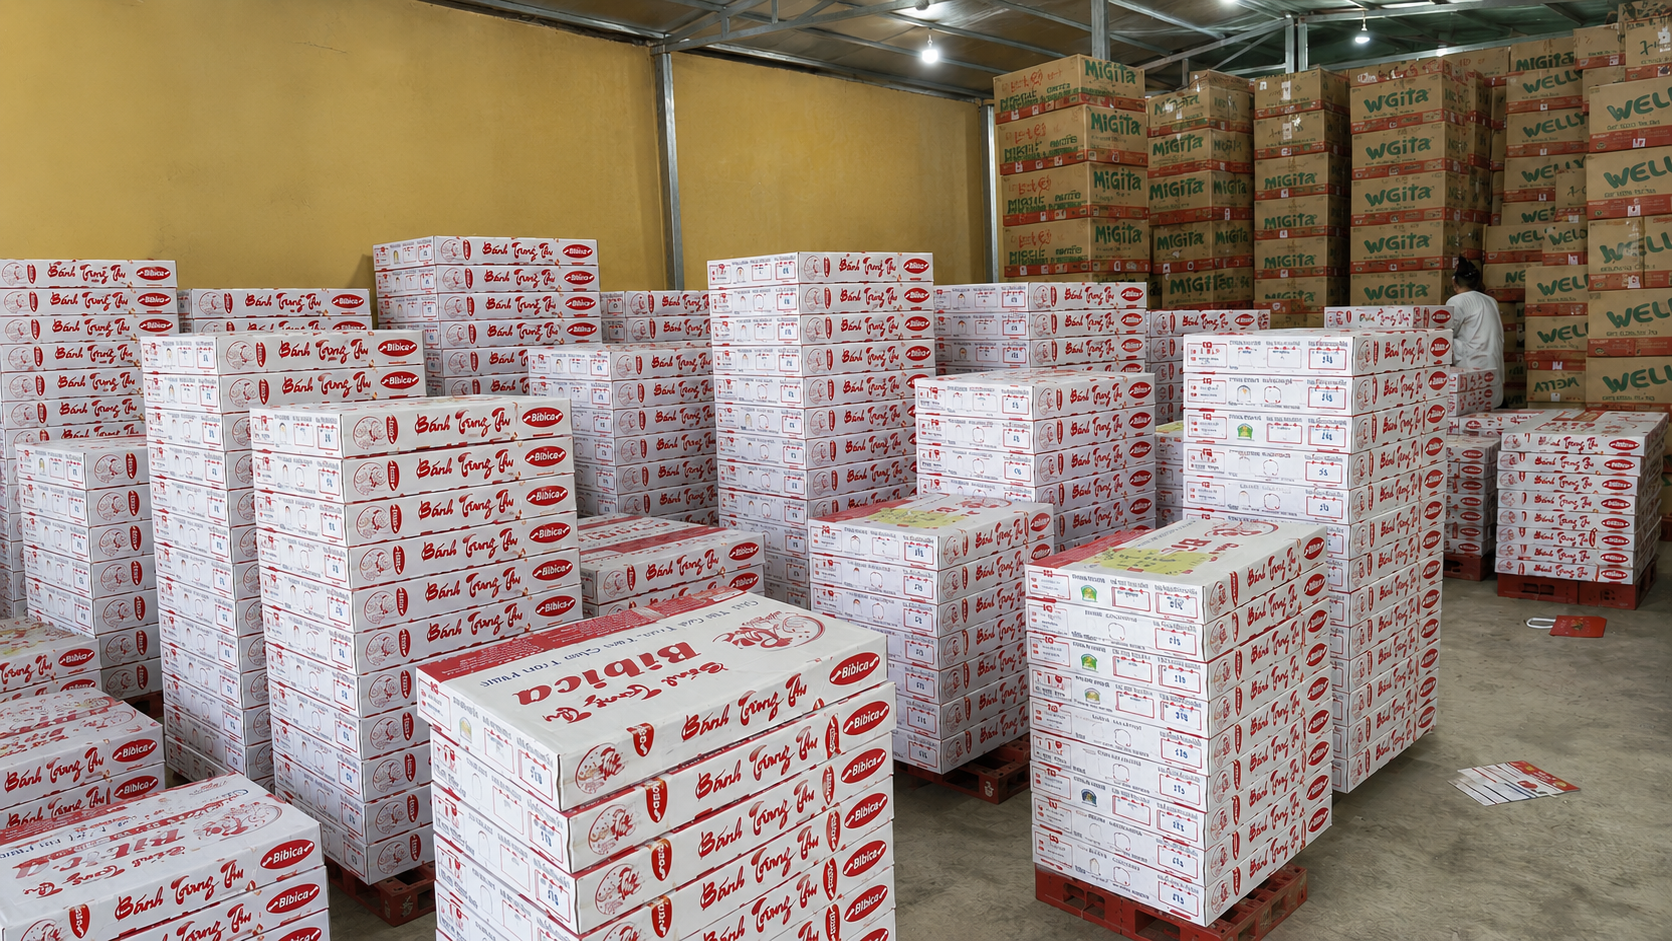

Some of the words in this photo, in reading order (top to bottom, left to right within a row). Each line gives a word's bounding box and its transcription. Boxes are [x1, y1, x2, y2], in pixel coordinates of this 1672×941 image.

[280, 341, 310, 358] Bánh
[282, 377, 313, 394] Bánh
[415, 415, 450, 434] Bánh
[492, 407, 510, 432] Thu
[531, 413, 555, 422] Bibica
[416, 458, 452, 478] Bánh
[495, 449, 513, 473] Thu
[535, 451, 559, 461] Bibica
[419, 499, 453, 519] Bánh
[496, 489, 514, 513] Thu
[535, 490, 560, 500] Bibica
[422, 540, 457, 560] Bánh
[500, 528, 518, 551] Thu
[538, 526, 562, 538] Bibica
[426, 580, 460, 601] Bánh
[503, 567, 520, 590] Thu
[542, 563, 565, 575] Bibica
[646, 561, 673, 581] Bánh
[428, 619, 462, 642] Bánh
[505, 603, 522, 627] Thu
[545, 599, 568, 611] Bibica
[512, 641, 701, 706] Bibica
[682, 704, 730, 741] Bánh
[786, 673, 807, 707] Thu
[842, 662, 869, 679] Bibica
[5, 767, 41, 792] Bánh
[85, 747, 103, 773] Thu
[123, 745, 148, 757] Bibica
[694, 759, 741, 799] Bánh
[796, 732, 818, 760] Thu
[854, 709, 880, 729] Bibica
[124, 782, 148, 795] Bibica
[697, 816, 743, 861] Bánh
[794, 782, 814, 813] Thu
[852, 757, 877, 777] Bibica
[699, 865, 746, 910] Bánh
[797, 825, 819, 860] Thu
[855, 802, 879, 822] Bibica
[115, 887, 164, 922] Bánh
[220, 860, 243, 888] Thu
[273, 847, 304, 864] Bibica
[796, 873, 817, 908] Thu
[853, 848, 878, 869] Bibica
[227, 903, 252, 933] Thu
[278, 891, 309, 907] Bibica
[855, 894, 879, 914] Bibica
